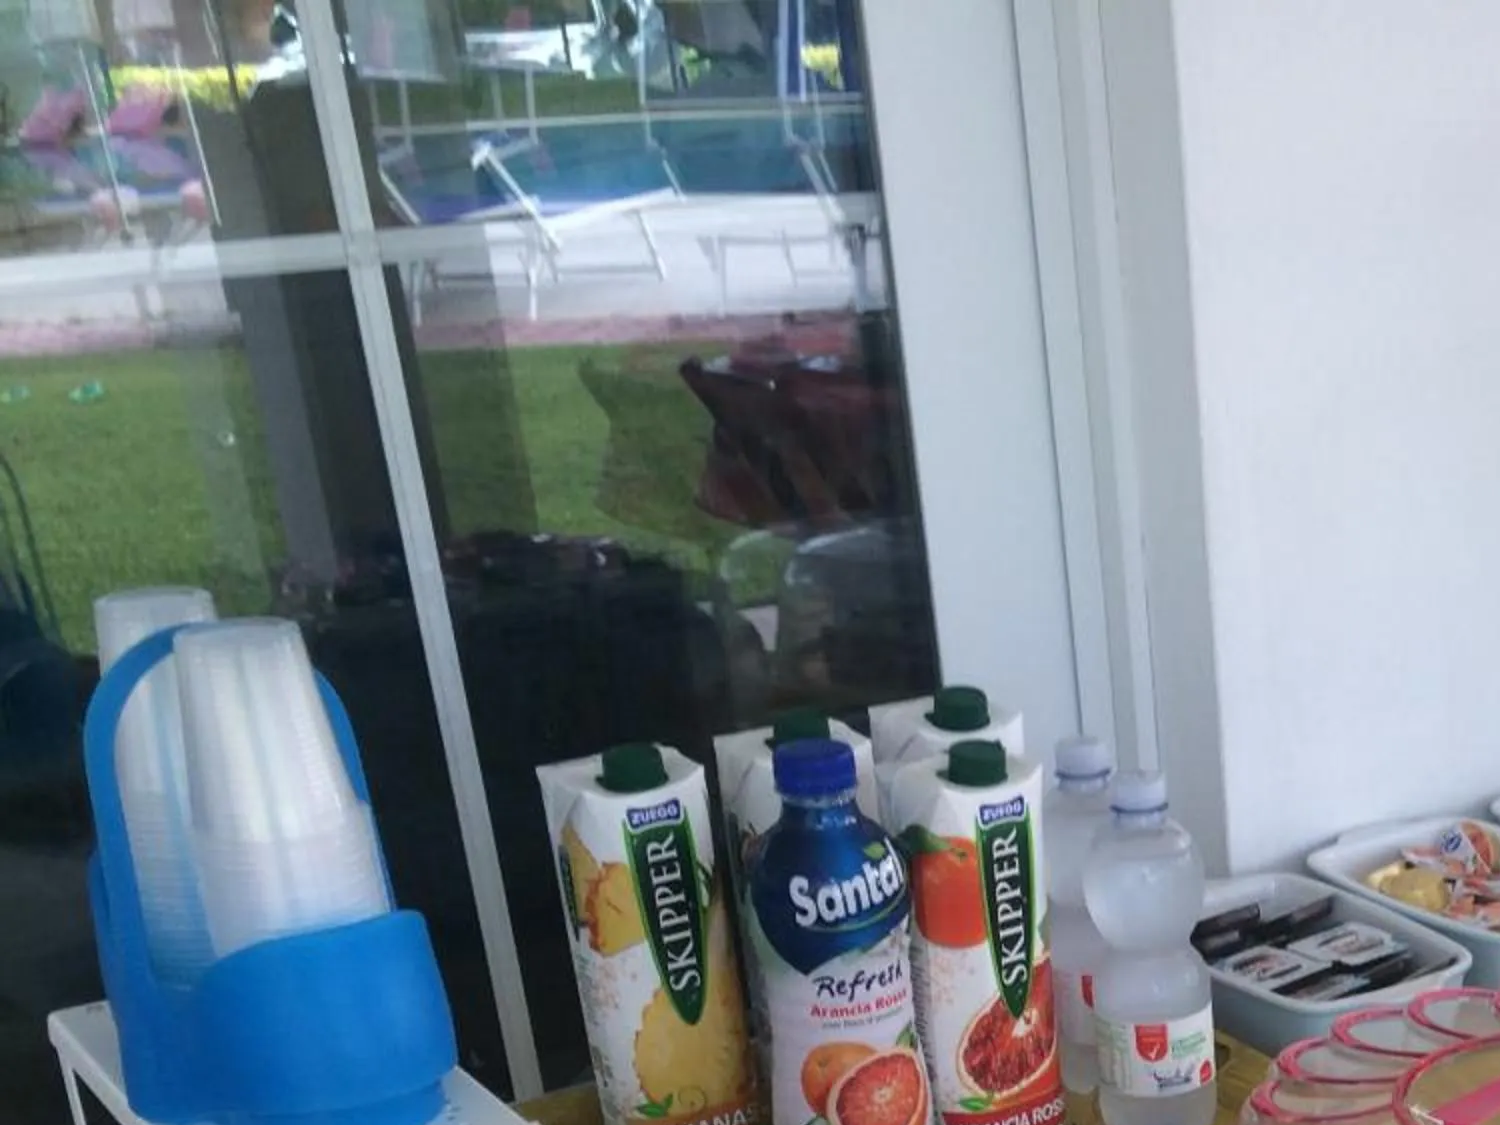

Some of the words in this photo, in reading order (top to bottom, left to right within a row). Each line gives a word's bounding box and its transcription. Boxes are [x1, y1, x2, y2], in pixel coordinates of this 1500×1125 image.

[629, 803, 678, 825] ZUEGG
[646, 831, 701, 992] SKIPPER
[789, 837, 904, 927] Santal
[992, 825, 1028, 985] SKIPPER
